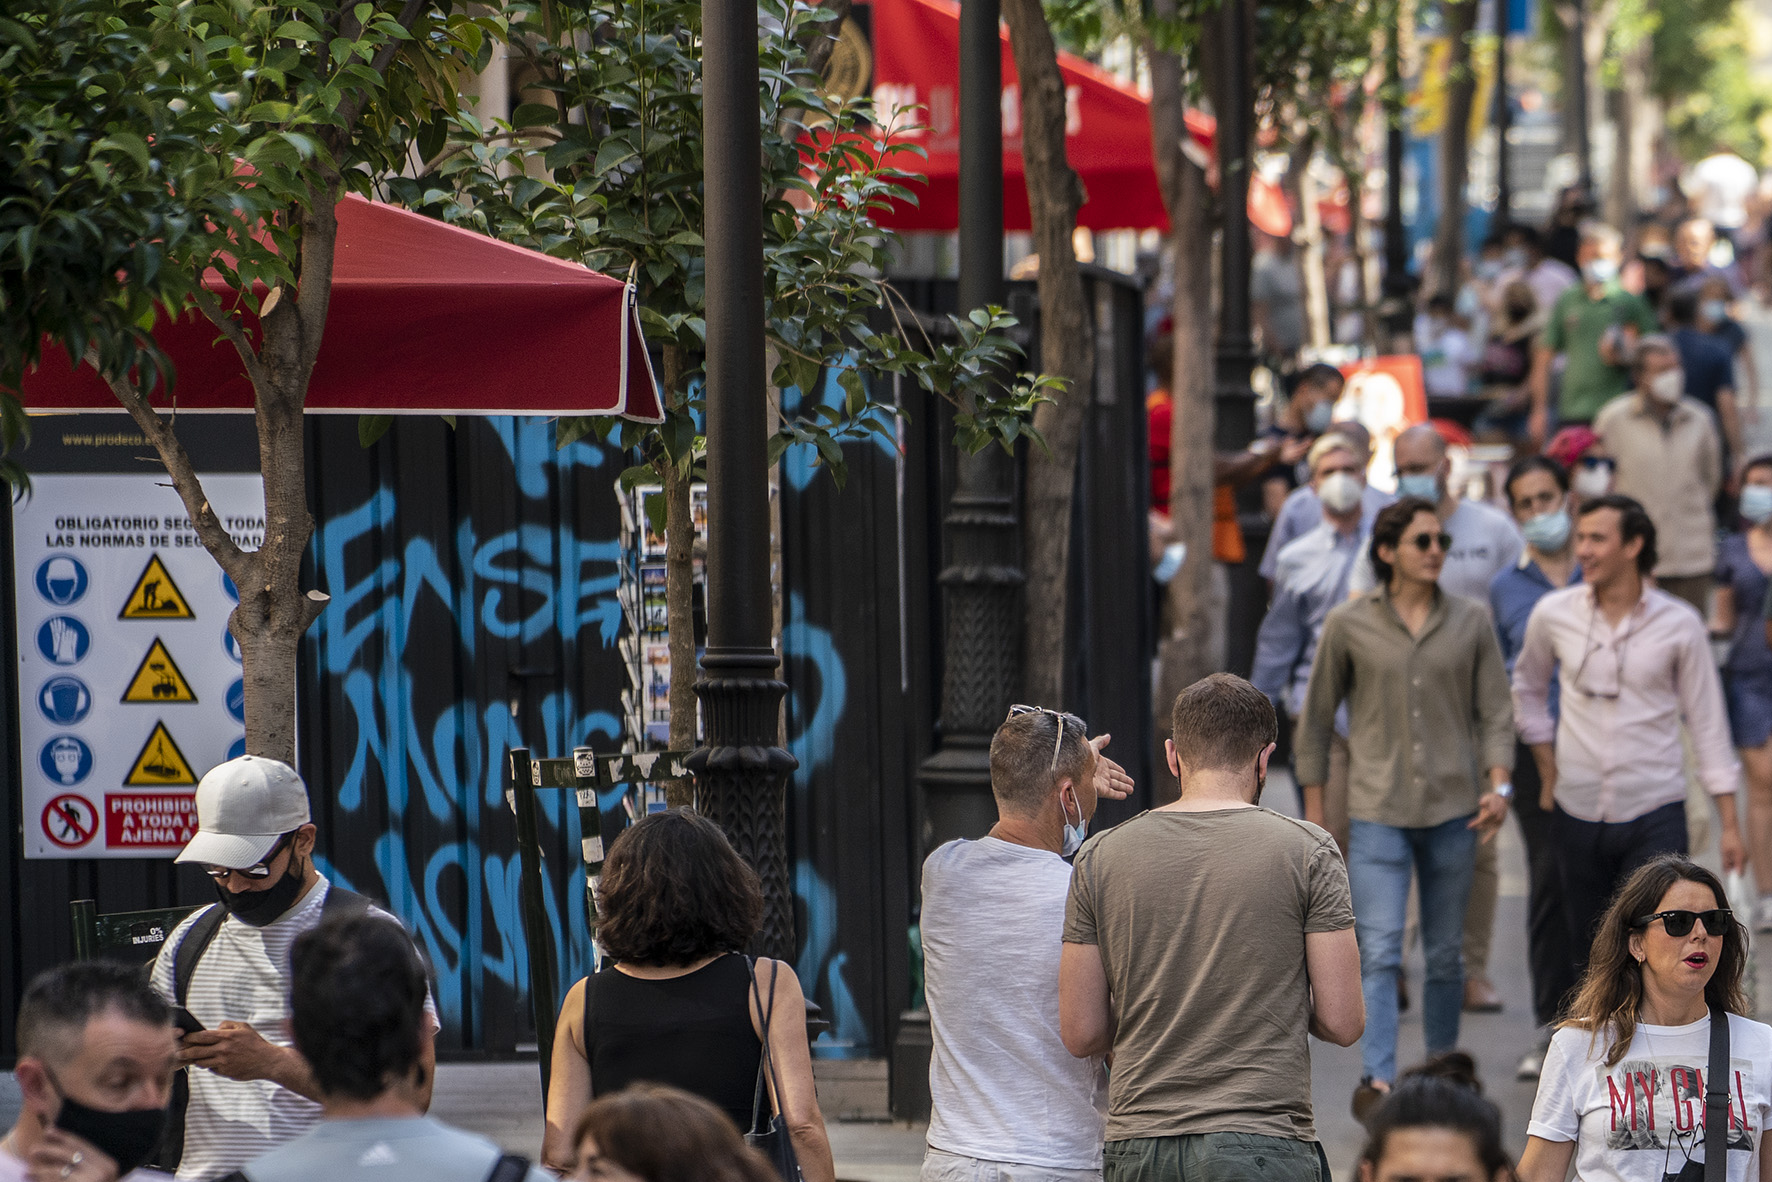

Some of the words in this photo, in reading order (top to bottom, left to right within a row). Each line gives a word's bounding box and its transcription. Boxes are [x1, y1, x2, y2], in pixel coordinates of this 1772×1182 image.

[62, 432, 153, 447] www.prodeco.e
[55, 516, 159, 531] OBLIGATORIO
[164, 516, 195, 531] SEG
[46, 535, 75, 548] LAS
[80, 534, 145, 548] NORMAS
[150, 534, 169, 548] DE
[122, 813, 134, 828] A
[139, 813, 184, 828] TODA
[122, 828, 176, 843] AJENA
[1606, 1069, 1656, 1132] MY
